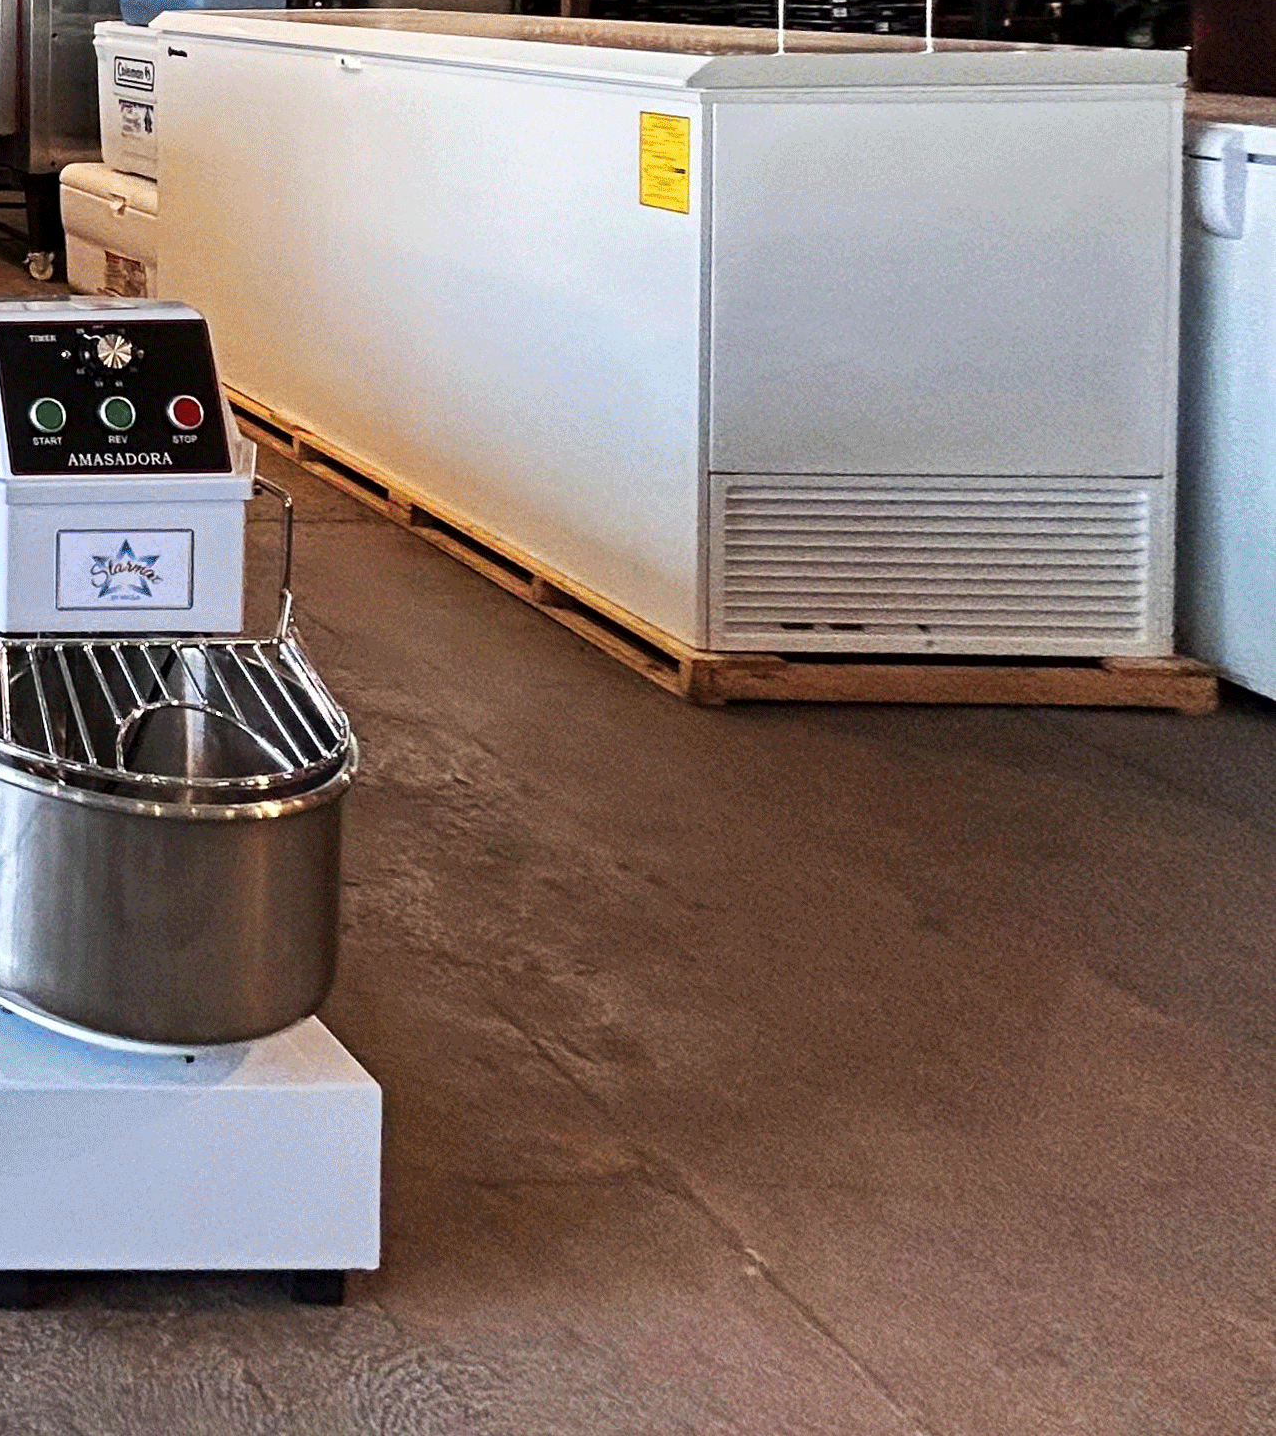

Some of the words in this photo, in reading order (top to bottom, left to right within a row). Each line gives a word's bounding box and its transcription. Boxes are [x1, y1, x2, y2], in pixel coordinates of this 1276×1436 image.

[29, 334, 57, 342] TIMER
[32, 436, 63, 446] START
[108, 435, 128, 444] REV
[172, 435, 198, 444] STOP
[68, 451, 173, 467] AMASADORA
